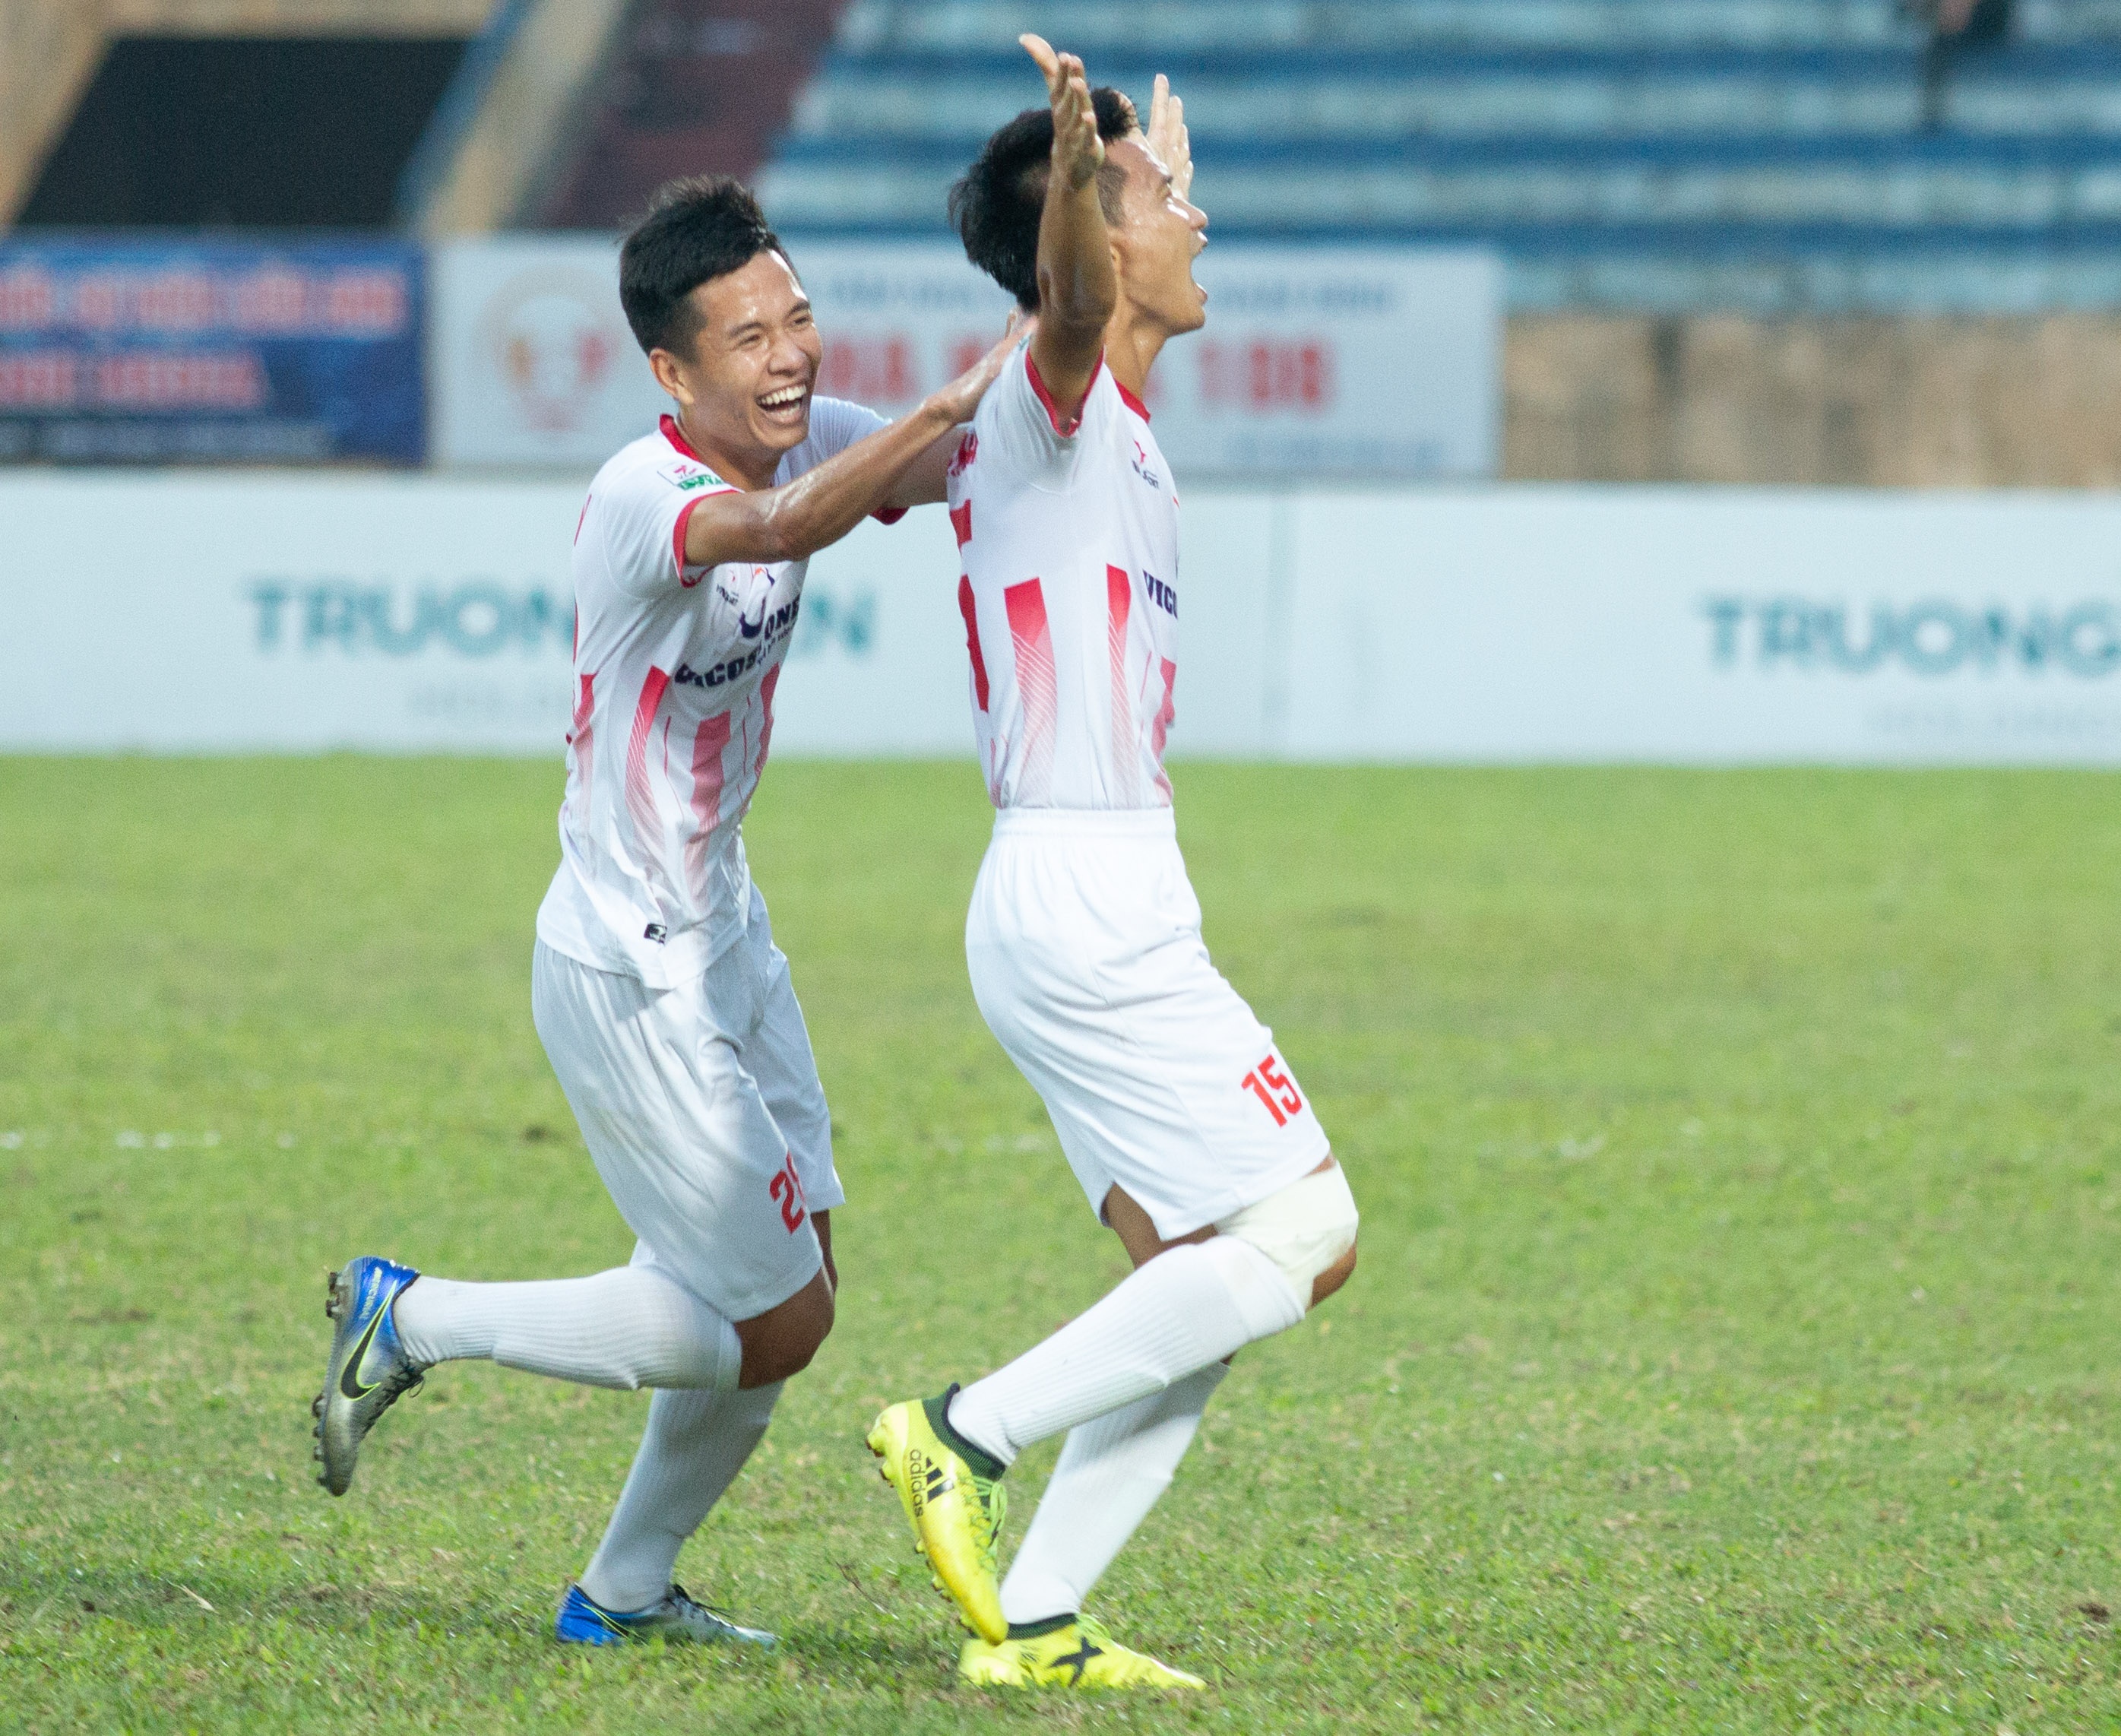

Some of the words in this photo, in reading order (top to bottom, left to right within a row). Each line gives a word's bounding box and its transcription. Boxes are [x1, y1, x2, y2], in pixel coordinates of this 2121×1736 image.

[1702, 591, 2121, 676] TRUONG
[1241, 1053, 1303, 1127] 15
[910, 1449, 926, 1517] adidas
